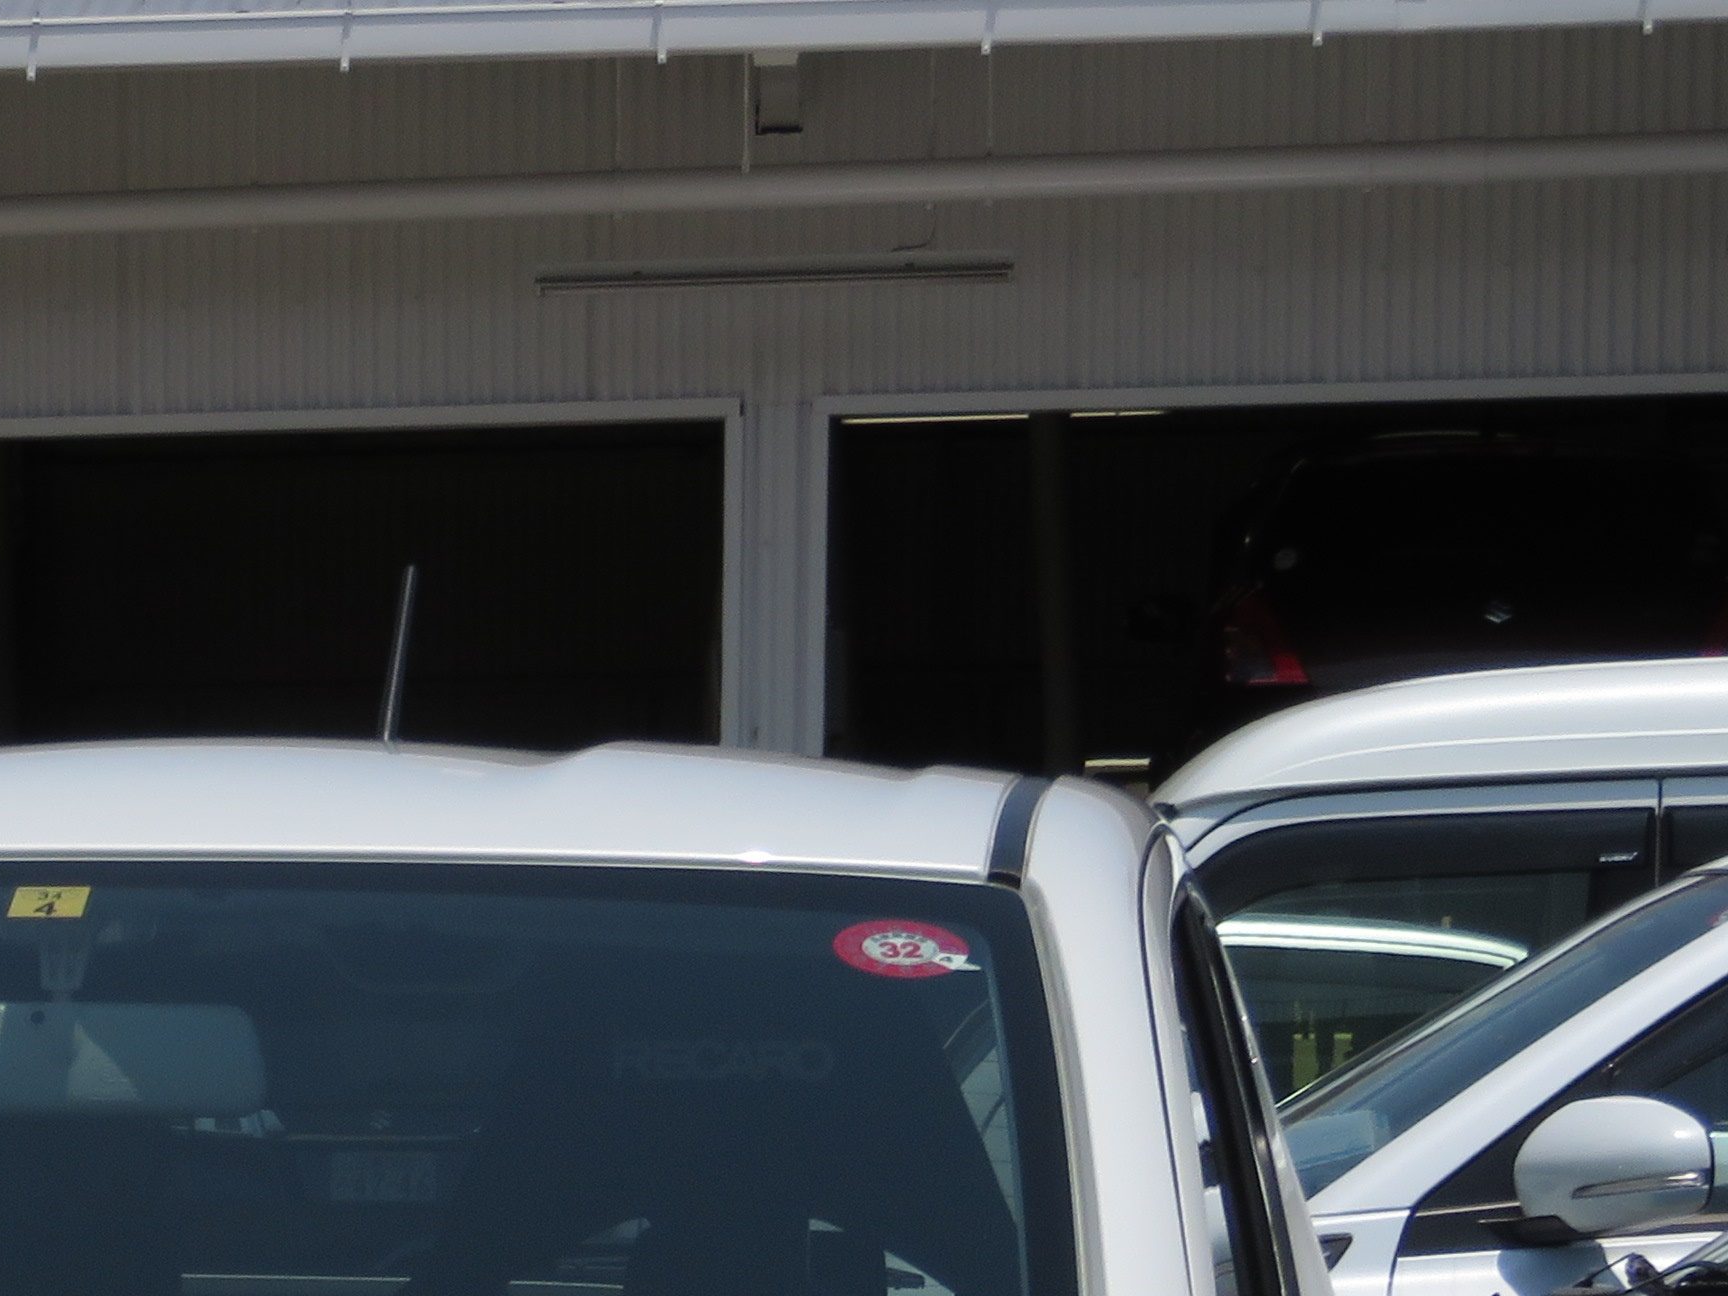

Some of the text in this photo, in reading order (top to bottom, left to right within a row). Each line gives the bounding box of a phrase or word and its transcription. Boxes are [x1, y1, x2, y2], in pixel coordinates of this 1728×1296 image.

[33, 901, 57, 915] 4
[878, 941, 924, 958] 32
[611, 1039, 835, 1081] RECARO
